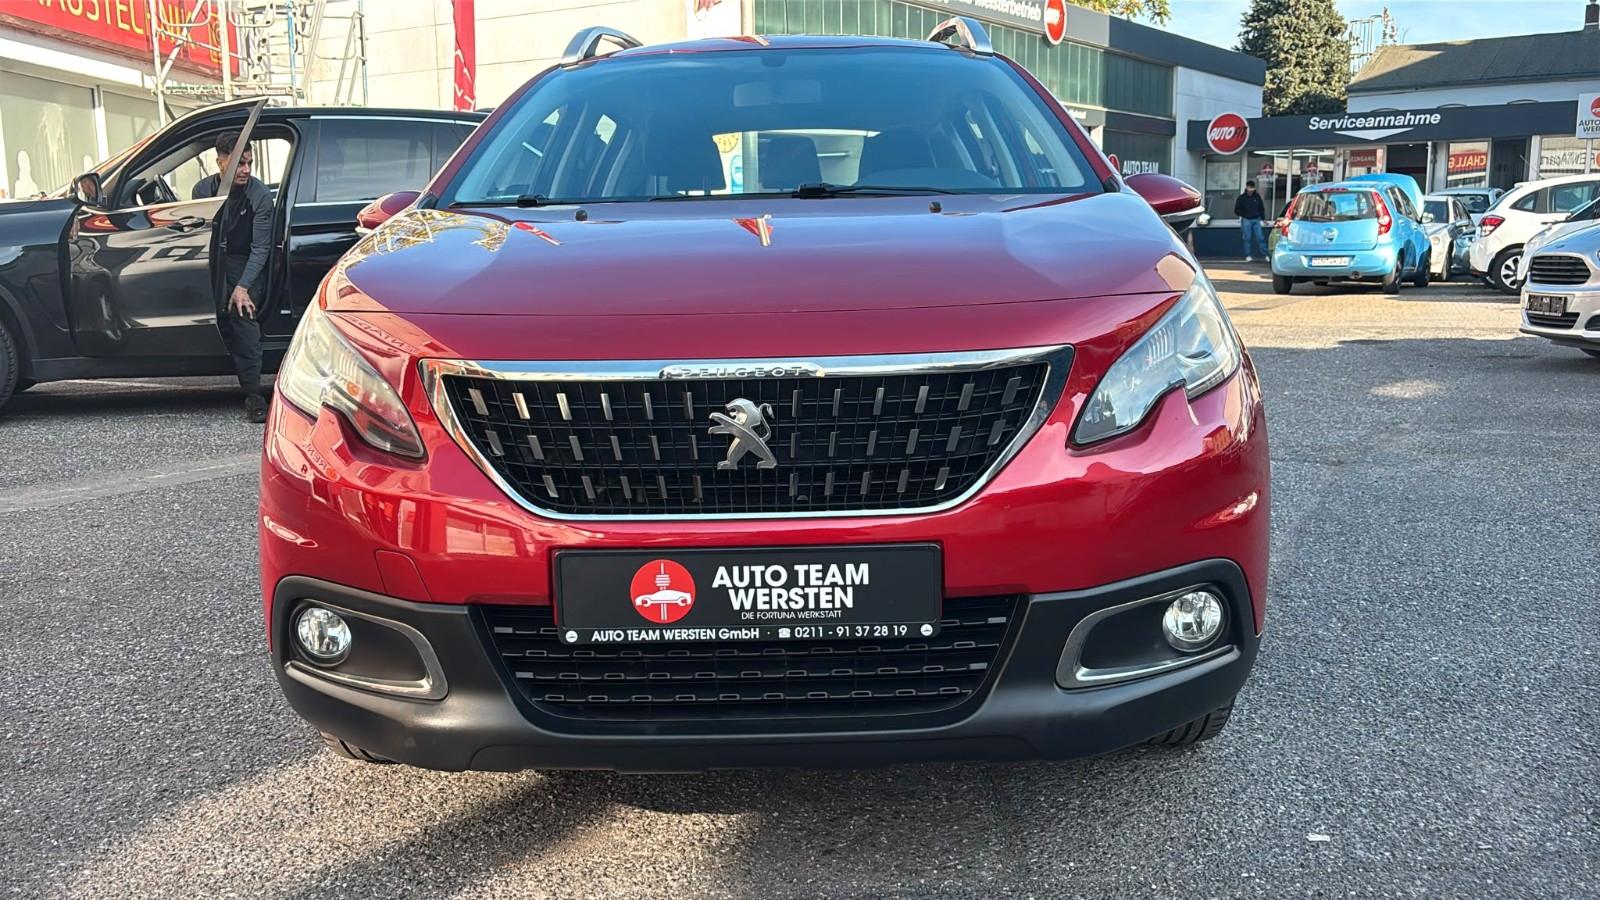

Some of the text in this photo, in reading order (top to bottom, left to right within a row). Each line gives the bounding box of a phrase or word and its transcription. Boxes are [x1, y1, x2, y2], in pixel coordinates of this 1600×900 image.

[1308, 112, 1441, 130] Serviceannahme
[1578, 119, 1600, 127] AUTO
[1122, 160, 1159, 174] AUTO TEAM
[681, 366, 803, 378] PEUGEOT
[711, 563, 869, 588] AUTO TEAM
[728, 586, 854, 610] WERSTEN
[741, 610, 842, 620] DIE FORTUNA WERKSTATT
[591, 630, 625, 642] AUTO
[627, 629, 660, 641] TEAM
[663, 629, 716, 641] WERSTEN
[718, 628, 760, 640] GmbH
[794, 627, 824, 639] 0211
[836, 626, 850, 638] 91
[855, 626, 870, 638] 37
[873, 625, 889, 637] 28
[893, 625, 908, 637] 19
